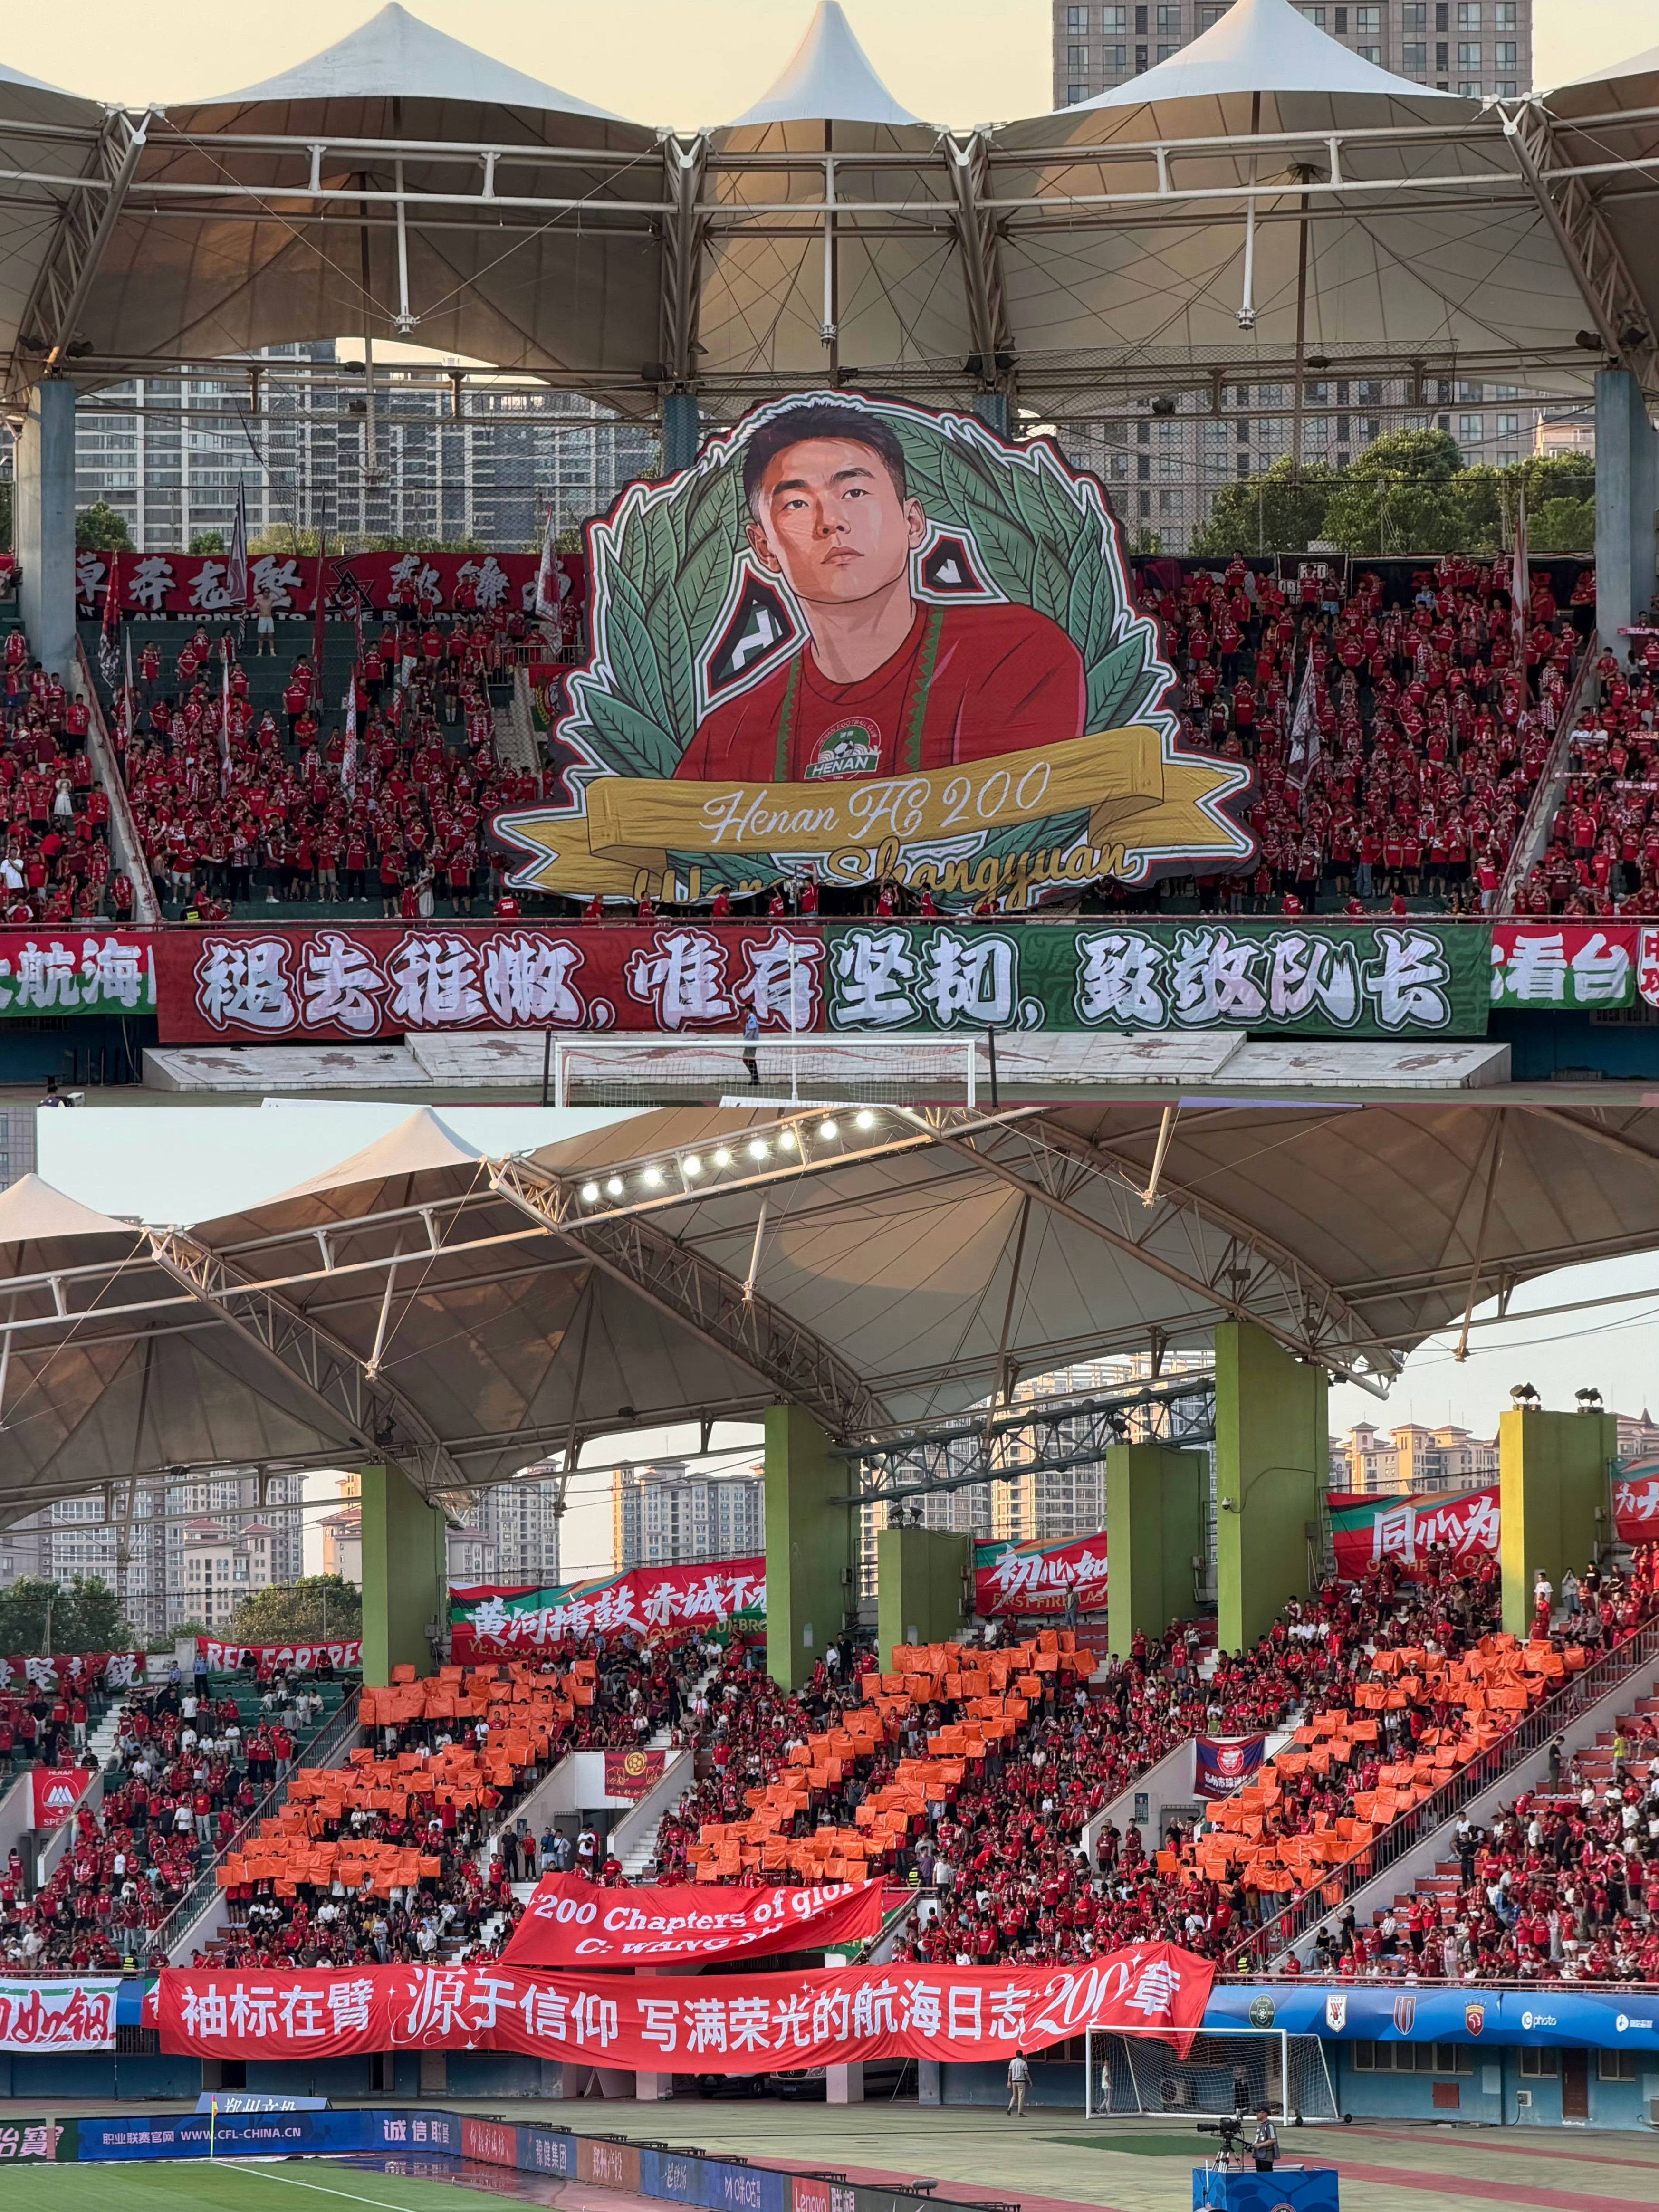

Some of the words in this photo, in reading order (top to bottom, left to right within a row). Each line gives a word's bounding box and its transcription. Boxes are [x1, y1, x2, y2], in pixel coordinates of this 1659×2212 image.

[134, 613, 167, 621] AN
[276, 612, 307, 621] TO
[812, 756, 869, 776] HENAN
[699, 788, 839, 844] Henan
[848, 777, 931, 840] FC
[940, 761, 1051, 828] 200
[0, 937, 156, 1008] 航海
[1083, 931, 1446, 1025] 致敬队长
[1491, 933, 1630, 1001] 看台
[465, 1585, 649, 1647] 黄河擂鼓
[993, 1593, 1031, 1608] FIRST
[1080, 1591, 1107, 1603] LAS
[534, 1894, 597, 1925] 200
[604, 1907, 747, 1935] Chapters
[753, 1888, 786, 1923] of
[181, 1978, 374, 2038] 袖标在臂
[404, 1967, 618, 2048] 源于信仰
[637, 1960, 1181, 2053] 写满荣光的航海日志200章
[102, 2131, 174, 2145] 职业联赛官网
[180, 2127, 301, 2141] WWW.CFL-CHINA.CN
[383, 2119, 450, 2145] 诚信联赛
[536, 2138, 566, 2171] 豫健集团
[796, 2187, 827, 2212] Lenovo
